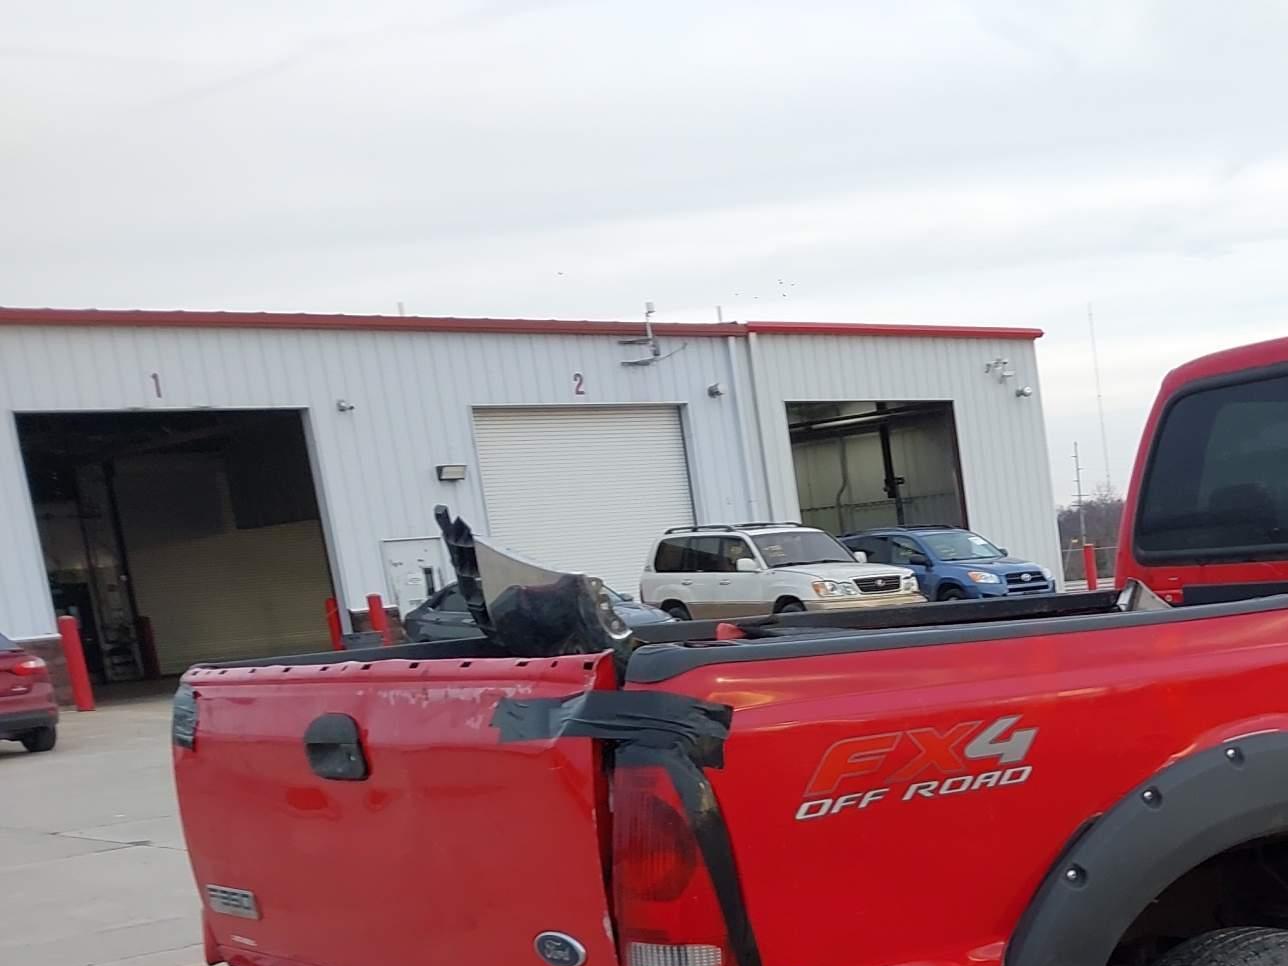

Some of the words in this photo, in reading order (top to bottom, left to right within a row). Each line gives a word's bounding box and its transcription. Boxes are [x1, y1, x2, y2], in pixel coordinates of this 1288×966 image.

[151, 372, 162, 399] 1
[573, 372, 586, 396] 2
[803, 714, 1039, 798] FX4
[795, 788, 890, 820] OFF
[902, 766, 1033, 800] ROAD
[543, 939, 571, 961] Ford
